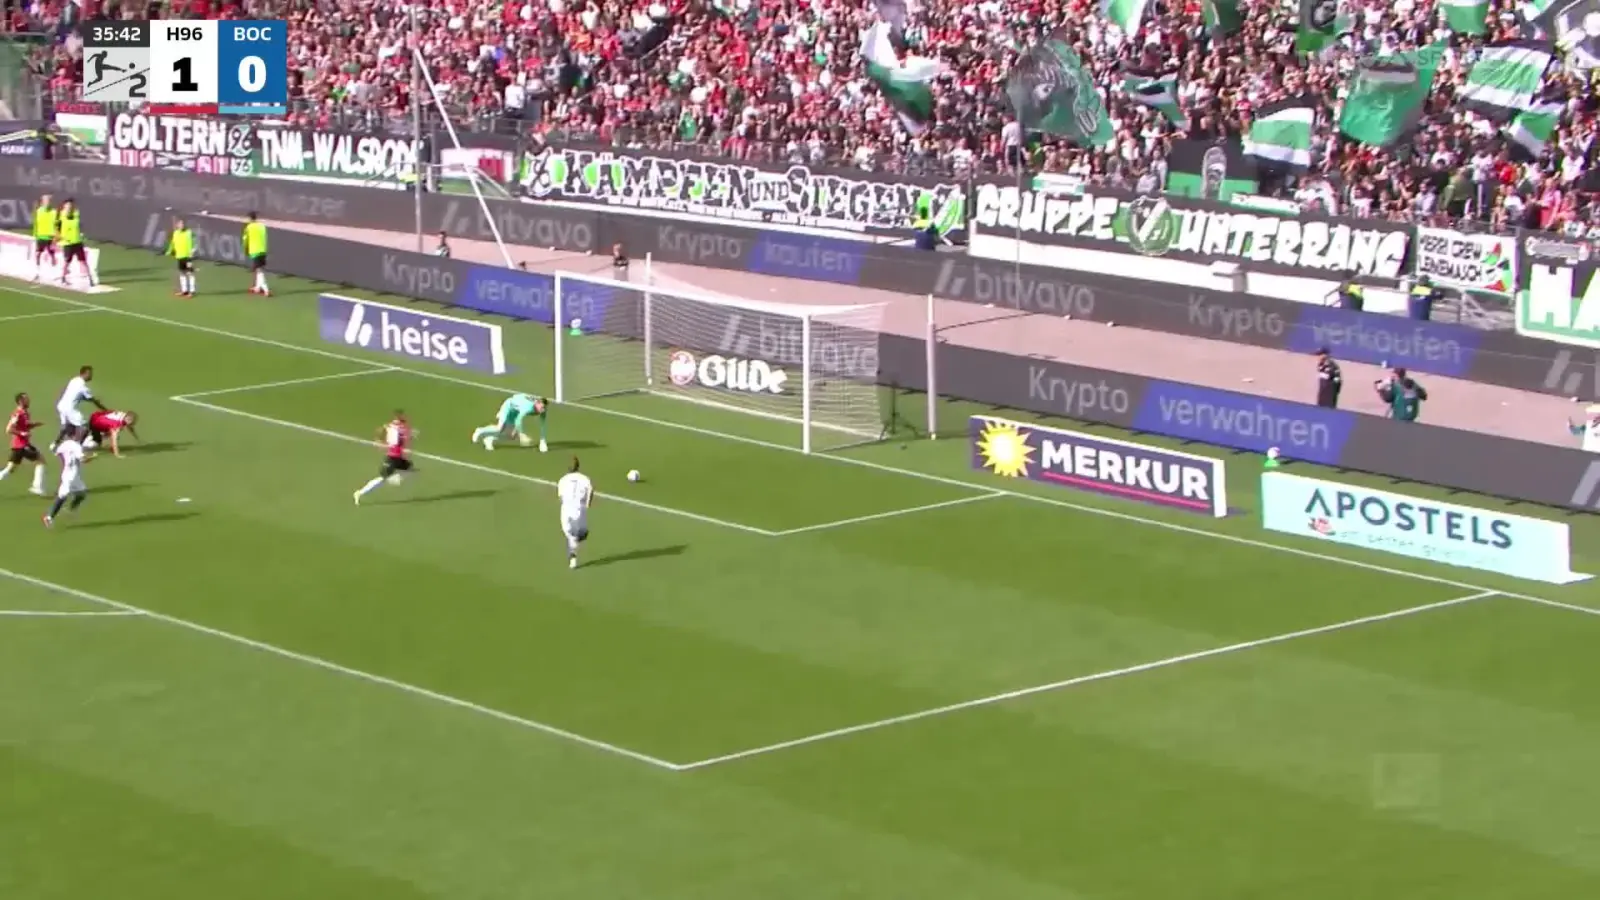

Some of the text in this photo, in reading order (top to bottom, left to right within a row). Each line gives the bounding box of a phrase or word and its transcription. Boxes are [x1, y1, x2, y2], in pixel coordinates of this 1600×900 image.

[114, 113, 227, 155] GOLTERN
[657, 224, 741, 258] Krypto
[975, 183, 1409, 278] GRUPPE UNTERRANG
[381, 253, 455, 293] Krypto
[973, 265, 1096, 315] bitvavo
[380, 310, 469, 365] heise
[1187, 292, 1461, 363] Krypto verkaufen
[1027, 365, 1330, 449] Krypto verwahren
[1041, 439, 1209, 500] MERKUR
[1304, 488, 1513, 549] APOSTELS
